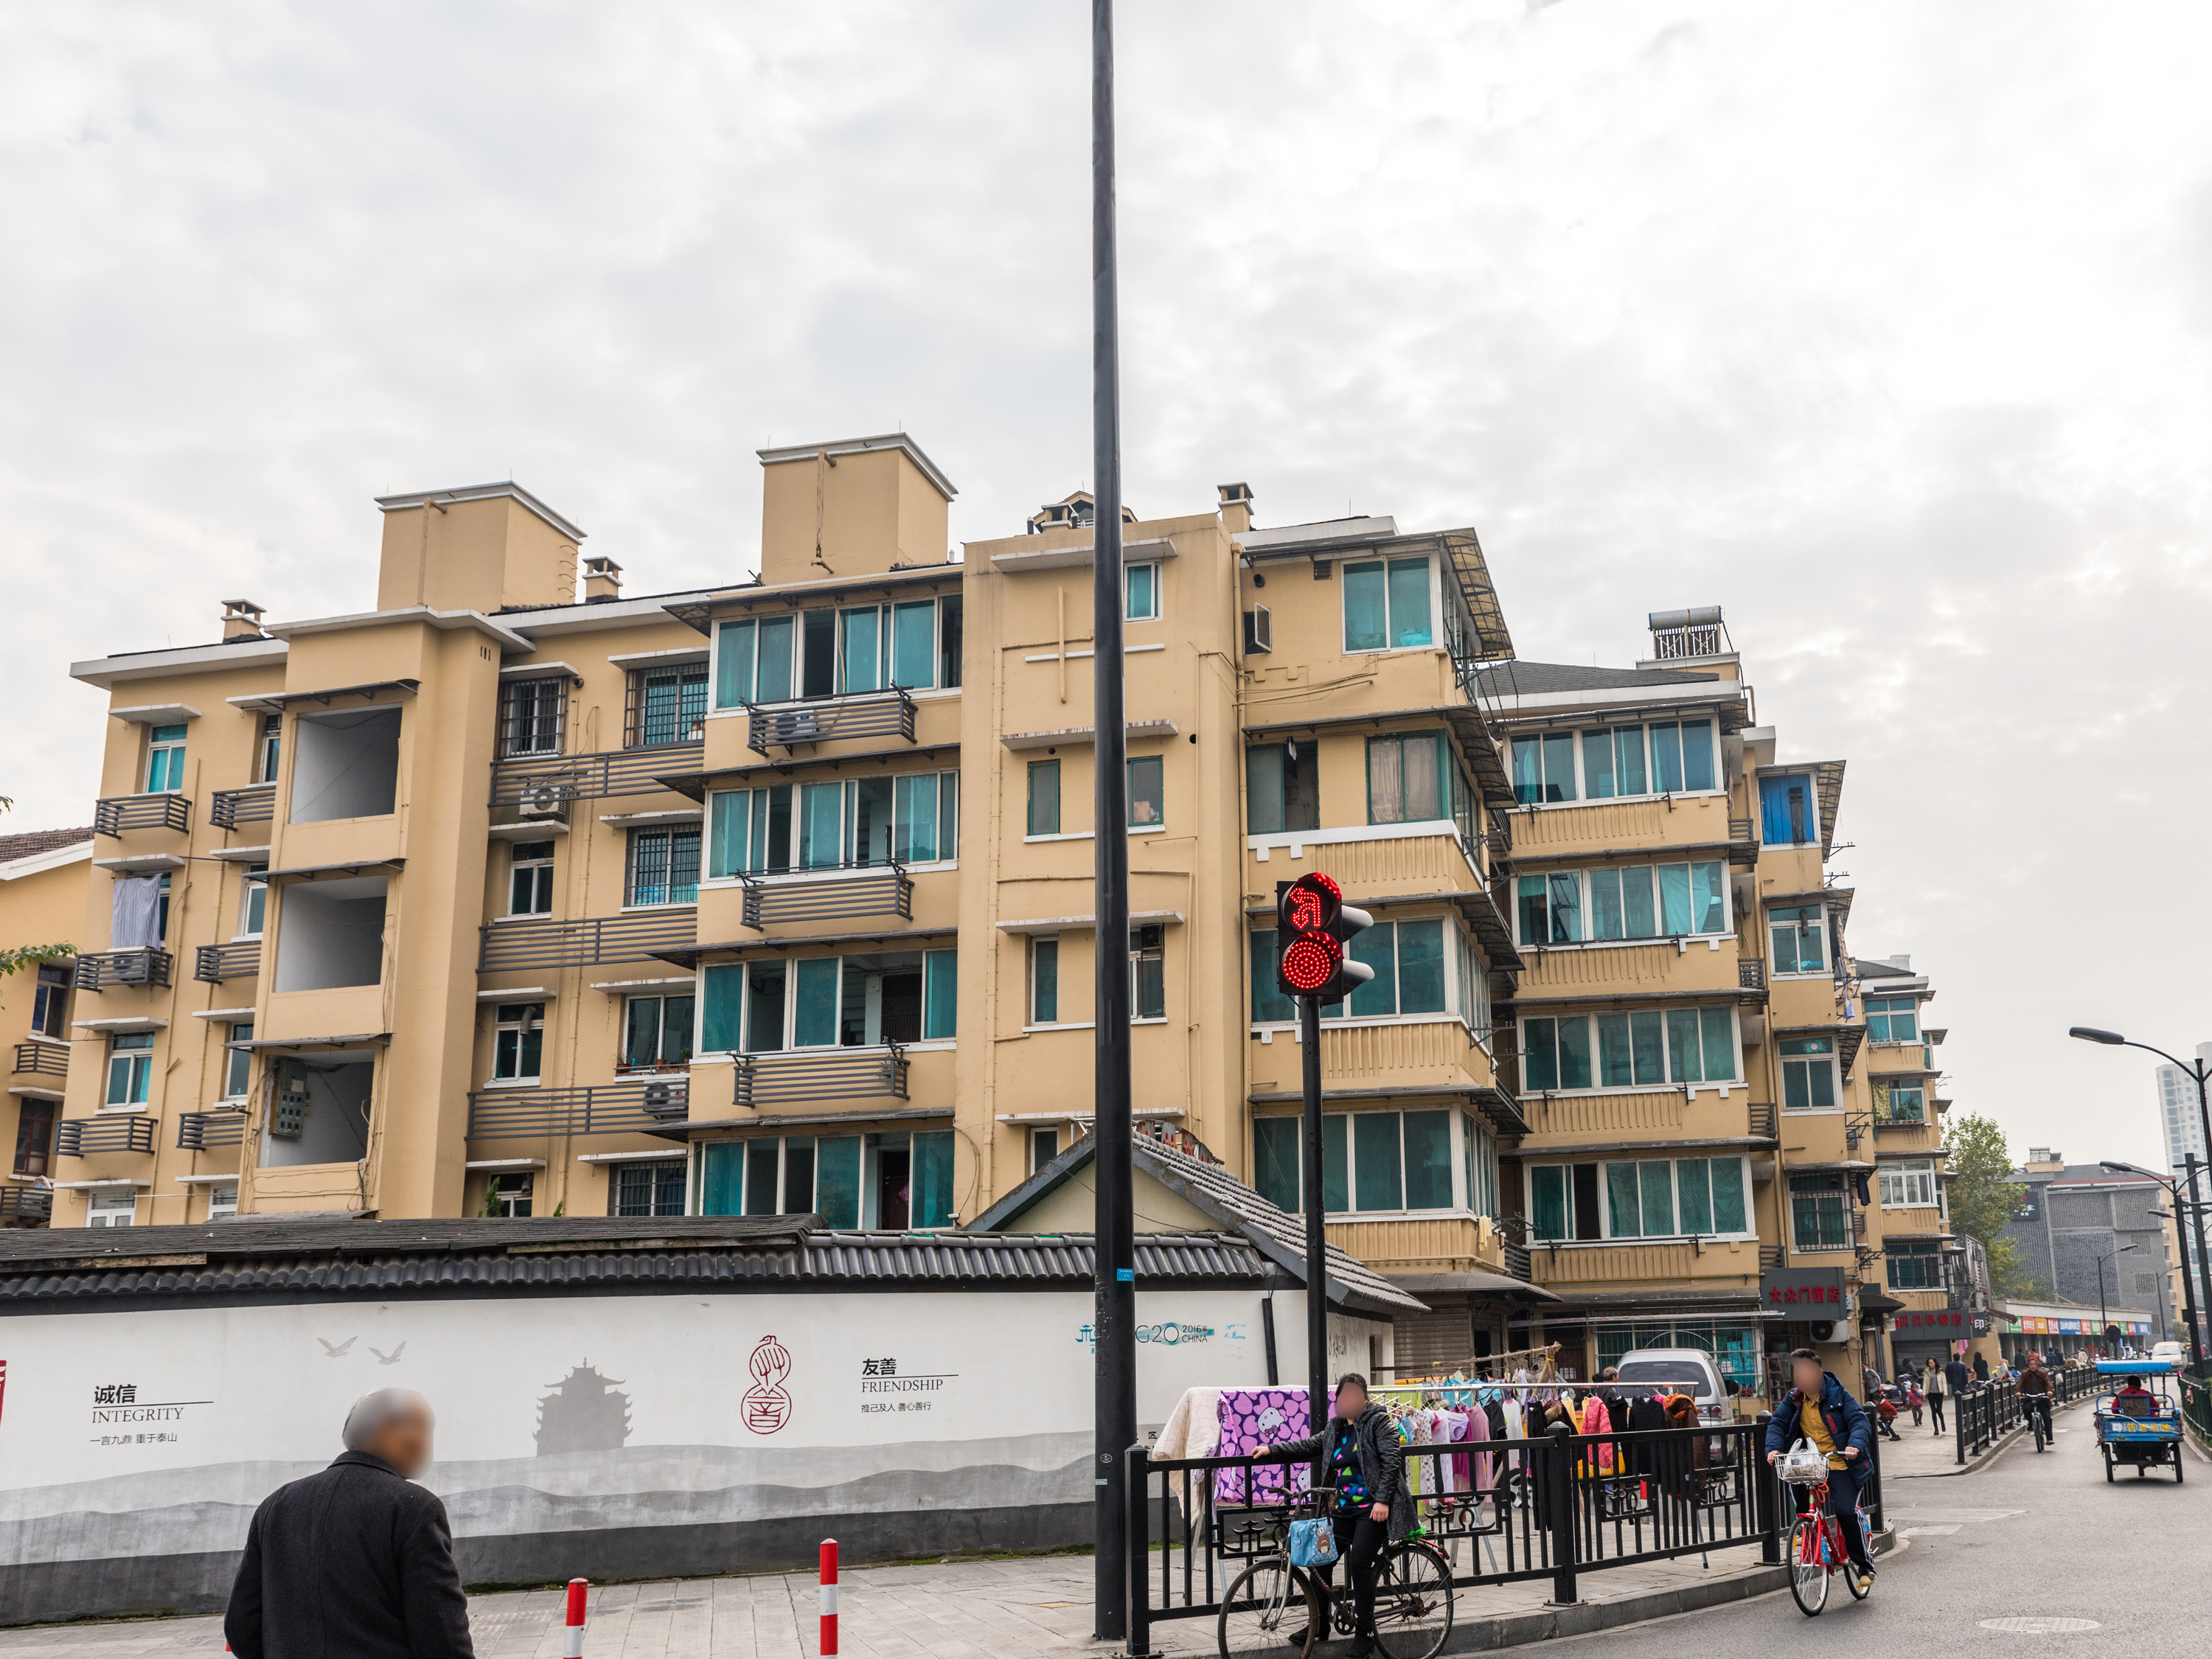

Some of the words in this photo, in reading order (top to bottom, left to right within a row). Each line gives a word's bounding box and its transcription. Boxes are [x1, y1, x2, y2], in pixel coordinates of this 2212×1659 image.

[1769, 1285, 1840, 1303] 大众门窗店
[1900, 1313, 1962, 1326] 贝贝早餐店
[1974, 1319, 1984, 1329] 印
[1135, 1325, 1180, 1343] G20
[1182, 1324, 1202, 1333] 2016
[1181, 1335, 1208, 1343] CHINA
[862, 1357, 897, 1376] 友善
[861, 1379, 943, 1393] FRIENDSHIP
[94, 1384, 137, 1404] 诚信
[861, 1403, 896, 1413] 推己及人
[898, 1402, 932, 1411] 善心善行
[92, 1408, 184, 1424] INTEGRITY
[90, 1435, 133, 1446] 一言九鼎
[136, 1433, 178, 1444] 重于泰山
